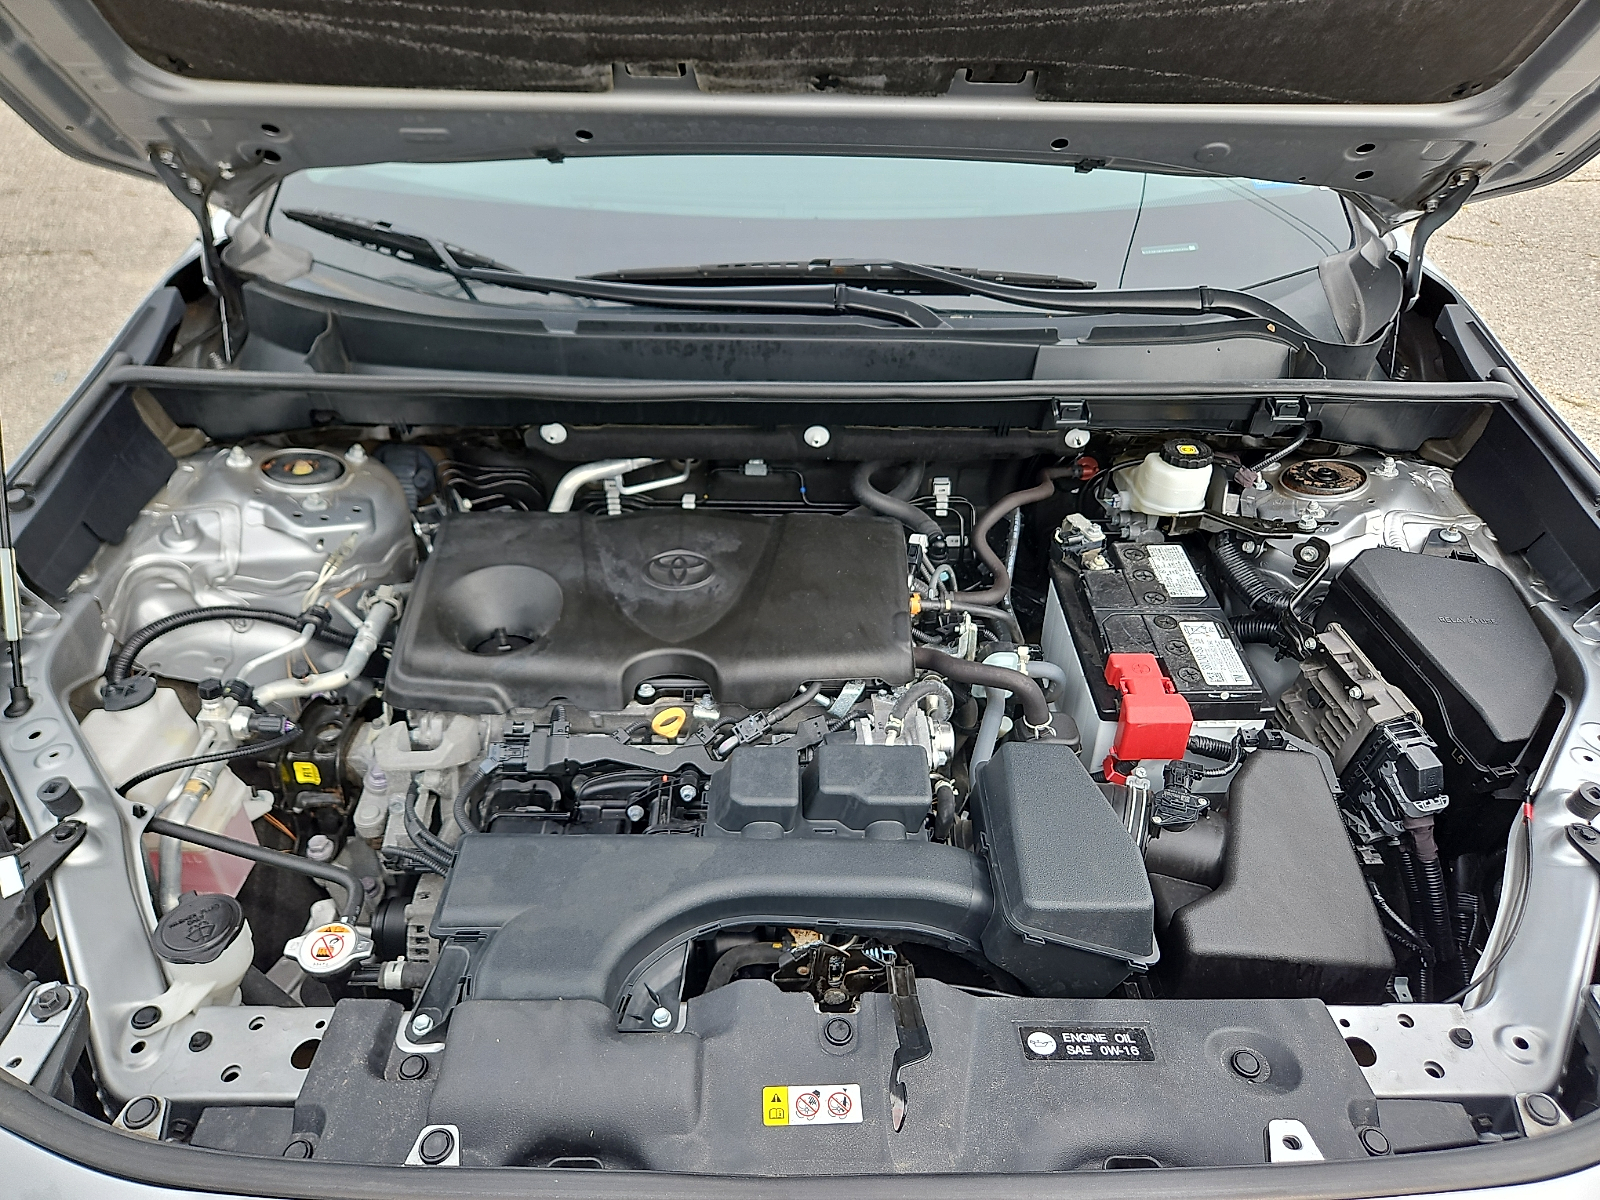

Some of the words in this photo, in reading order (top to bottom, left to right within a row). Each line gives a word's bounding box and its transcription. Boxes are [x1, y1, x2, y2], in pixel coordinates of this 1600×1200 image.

[1438, 616, 1466, 624] RELAY
[1061, 1032, 1108, 1043] ENGINE
[1114, 1033, 1136, 1044] OIL
[1066, 1045, 1093, 1056] SAE
[1100, 1045, 1140, 1056] 0W-16
